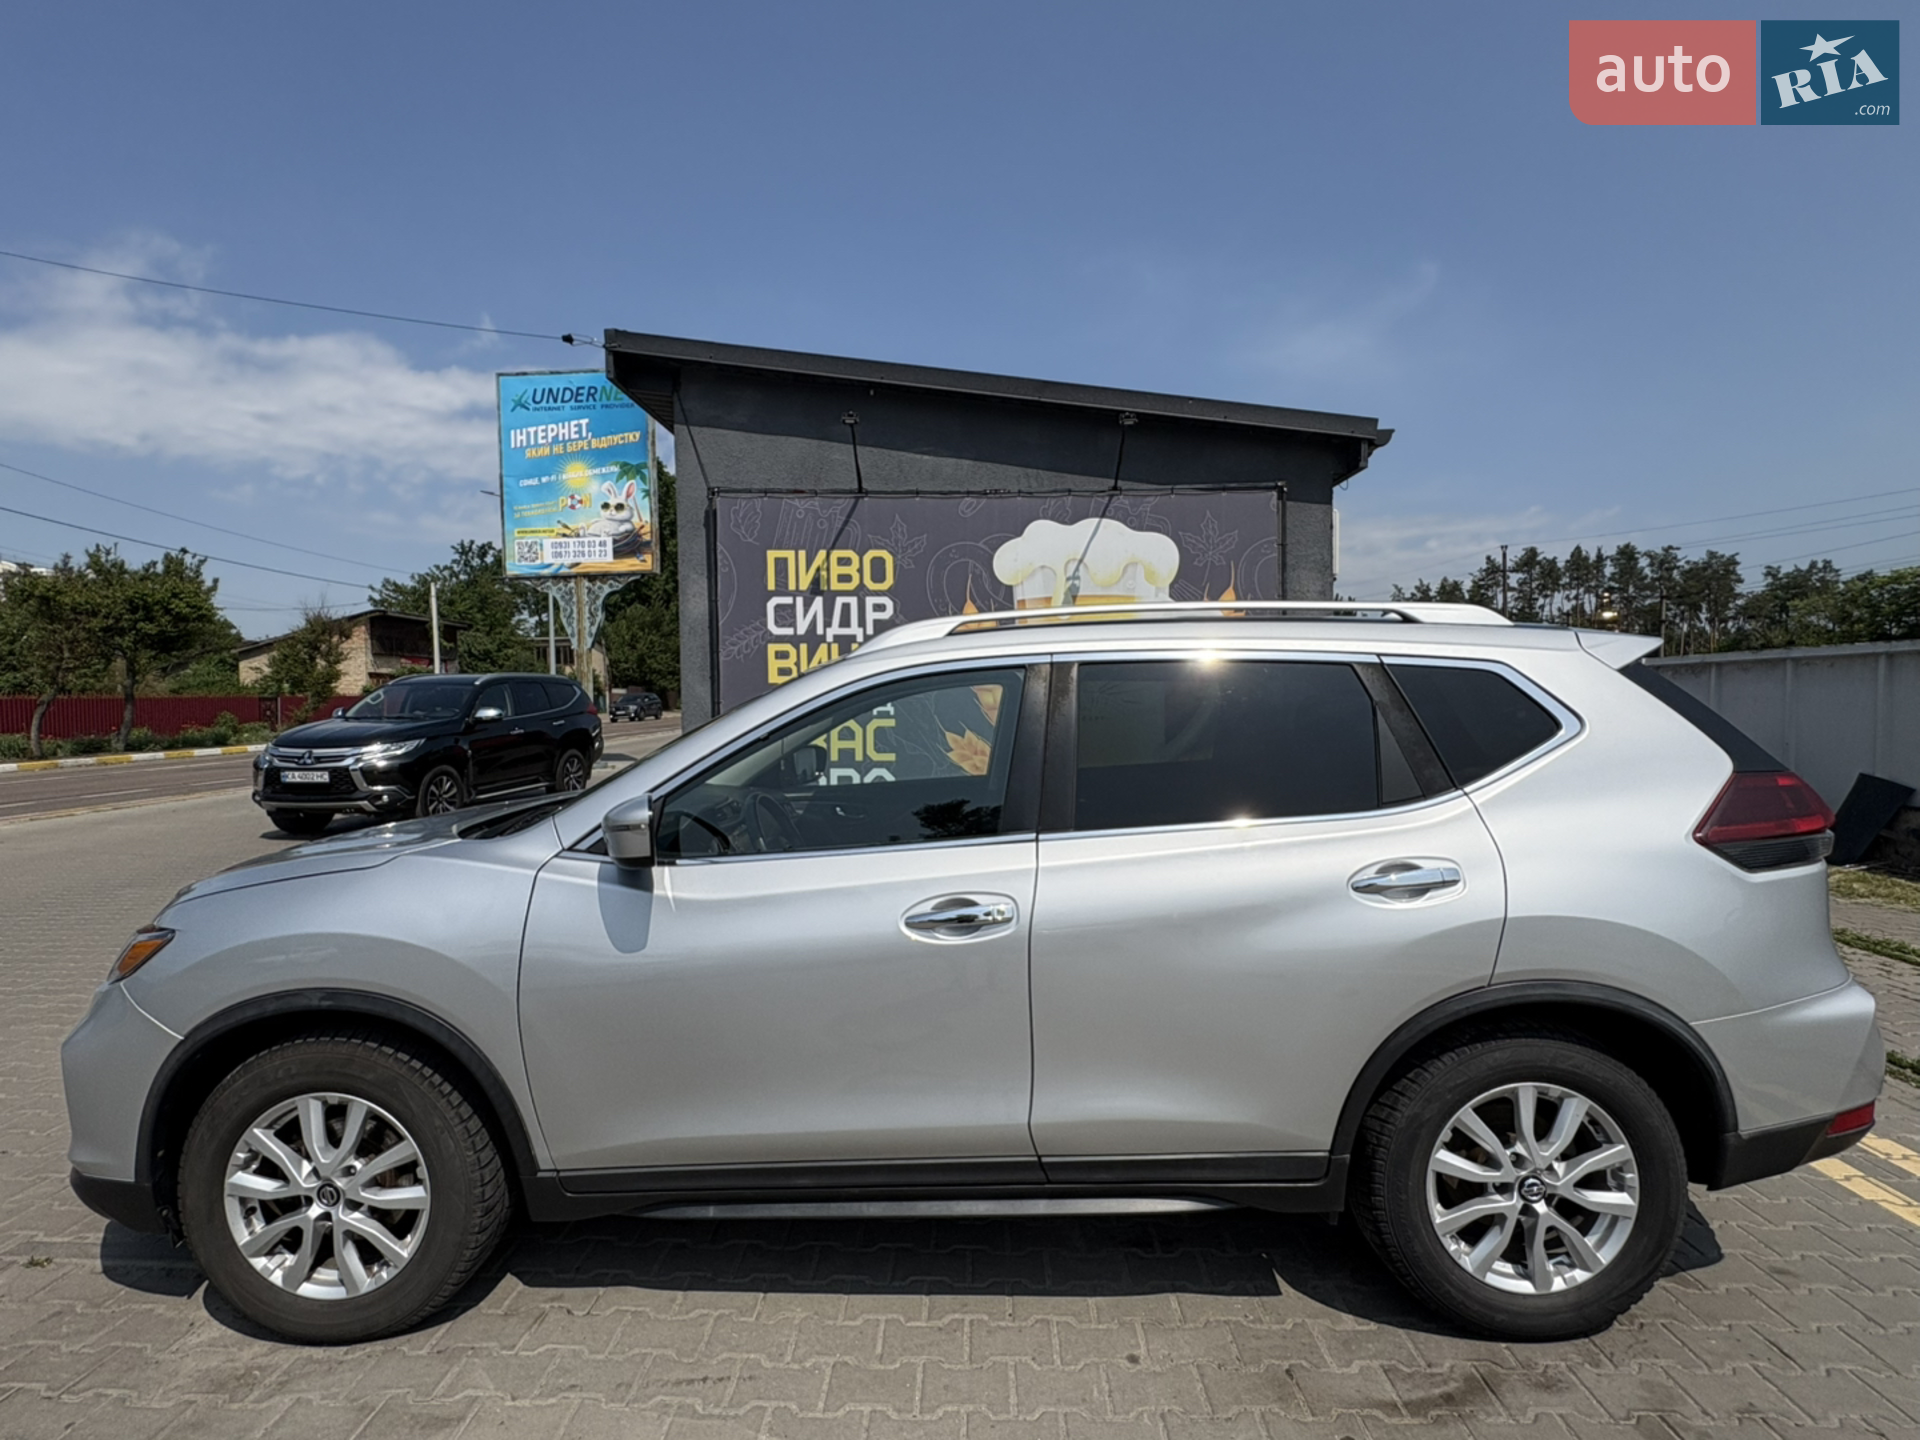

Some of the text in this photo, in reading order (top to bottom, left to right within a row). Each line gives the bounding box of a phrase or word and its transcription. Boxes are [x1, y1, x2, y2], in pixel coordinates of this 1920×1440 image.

[531, 385, 628, 405] UNDERNE
[600, 402, 636, 410] PROVIDER
[510, 418, 592, 449] ІНТЕРНЕТ,
[525, 431, 641, 459] ЯКИЙ НЕ БЕРЕ ВІДПУСТКУ
[551, 548, 608, 559] (067) 326 01 23
[572, 540, 586, 549] 170
[587, 540, 596, 548] 03
[766, 548, 894, 591] ПИВО
[766, 595, 894, 643] СИДР
